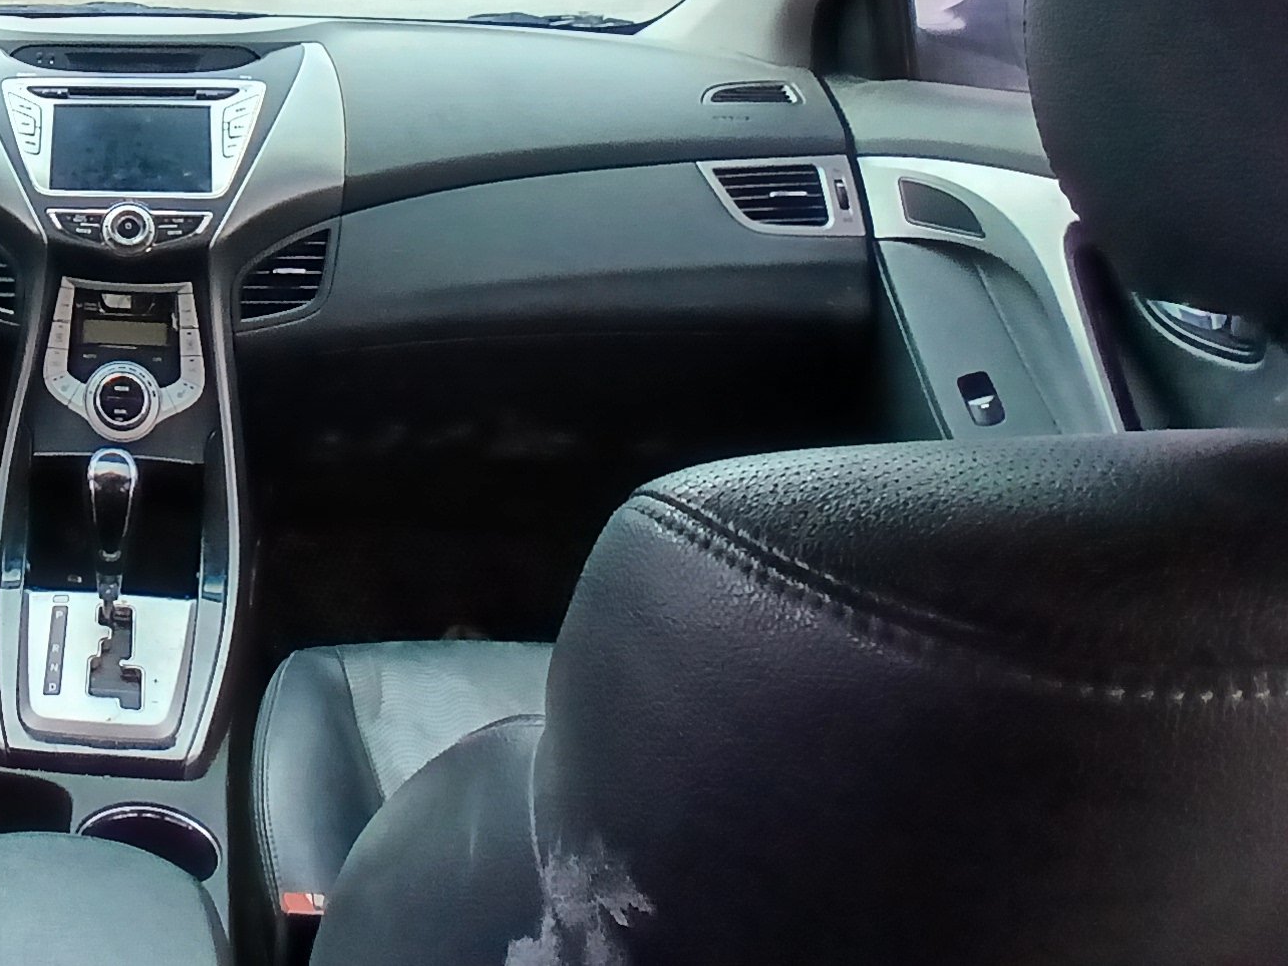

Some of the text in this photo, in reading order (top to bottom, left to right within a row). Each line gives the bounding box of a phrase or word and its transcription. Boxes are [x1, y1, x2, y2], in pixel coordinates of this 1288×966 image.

[55, 610, 64, 619] P
[51, 643, 60, 653] R
[49, 663, 59, 672] N
[48, 682, 57, 691] D
